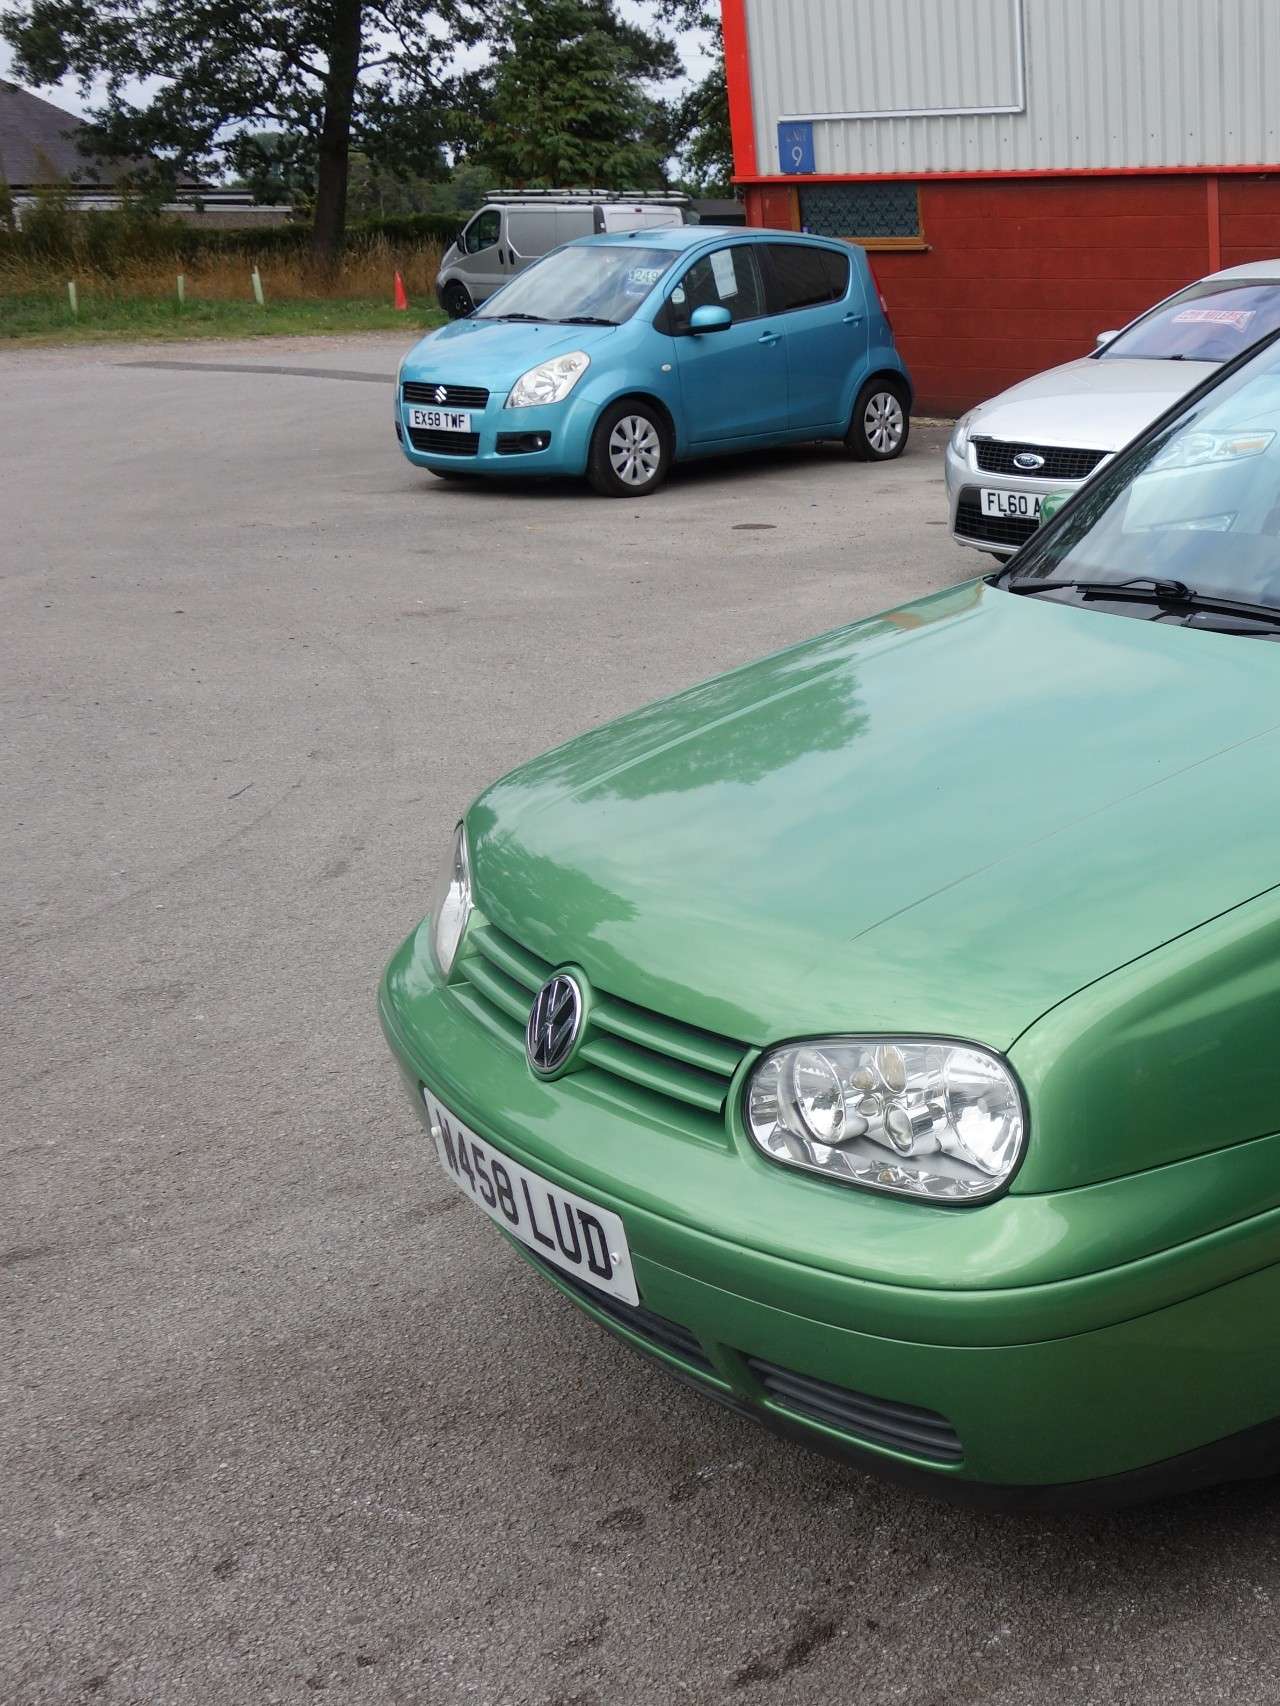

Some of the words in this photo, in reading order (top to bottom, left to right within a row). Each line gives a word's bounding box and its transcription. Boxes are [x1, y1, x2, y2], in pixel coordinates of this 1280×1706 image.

[791, 145, 803, 167] 9
[414, 410, 440, 427] EX58
[444, 413, 465, 429] TWF
[987, 492, 1028, 515] FL60
[520, 1176, 613, 1281] LUD
